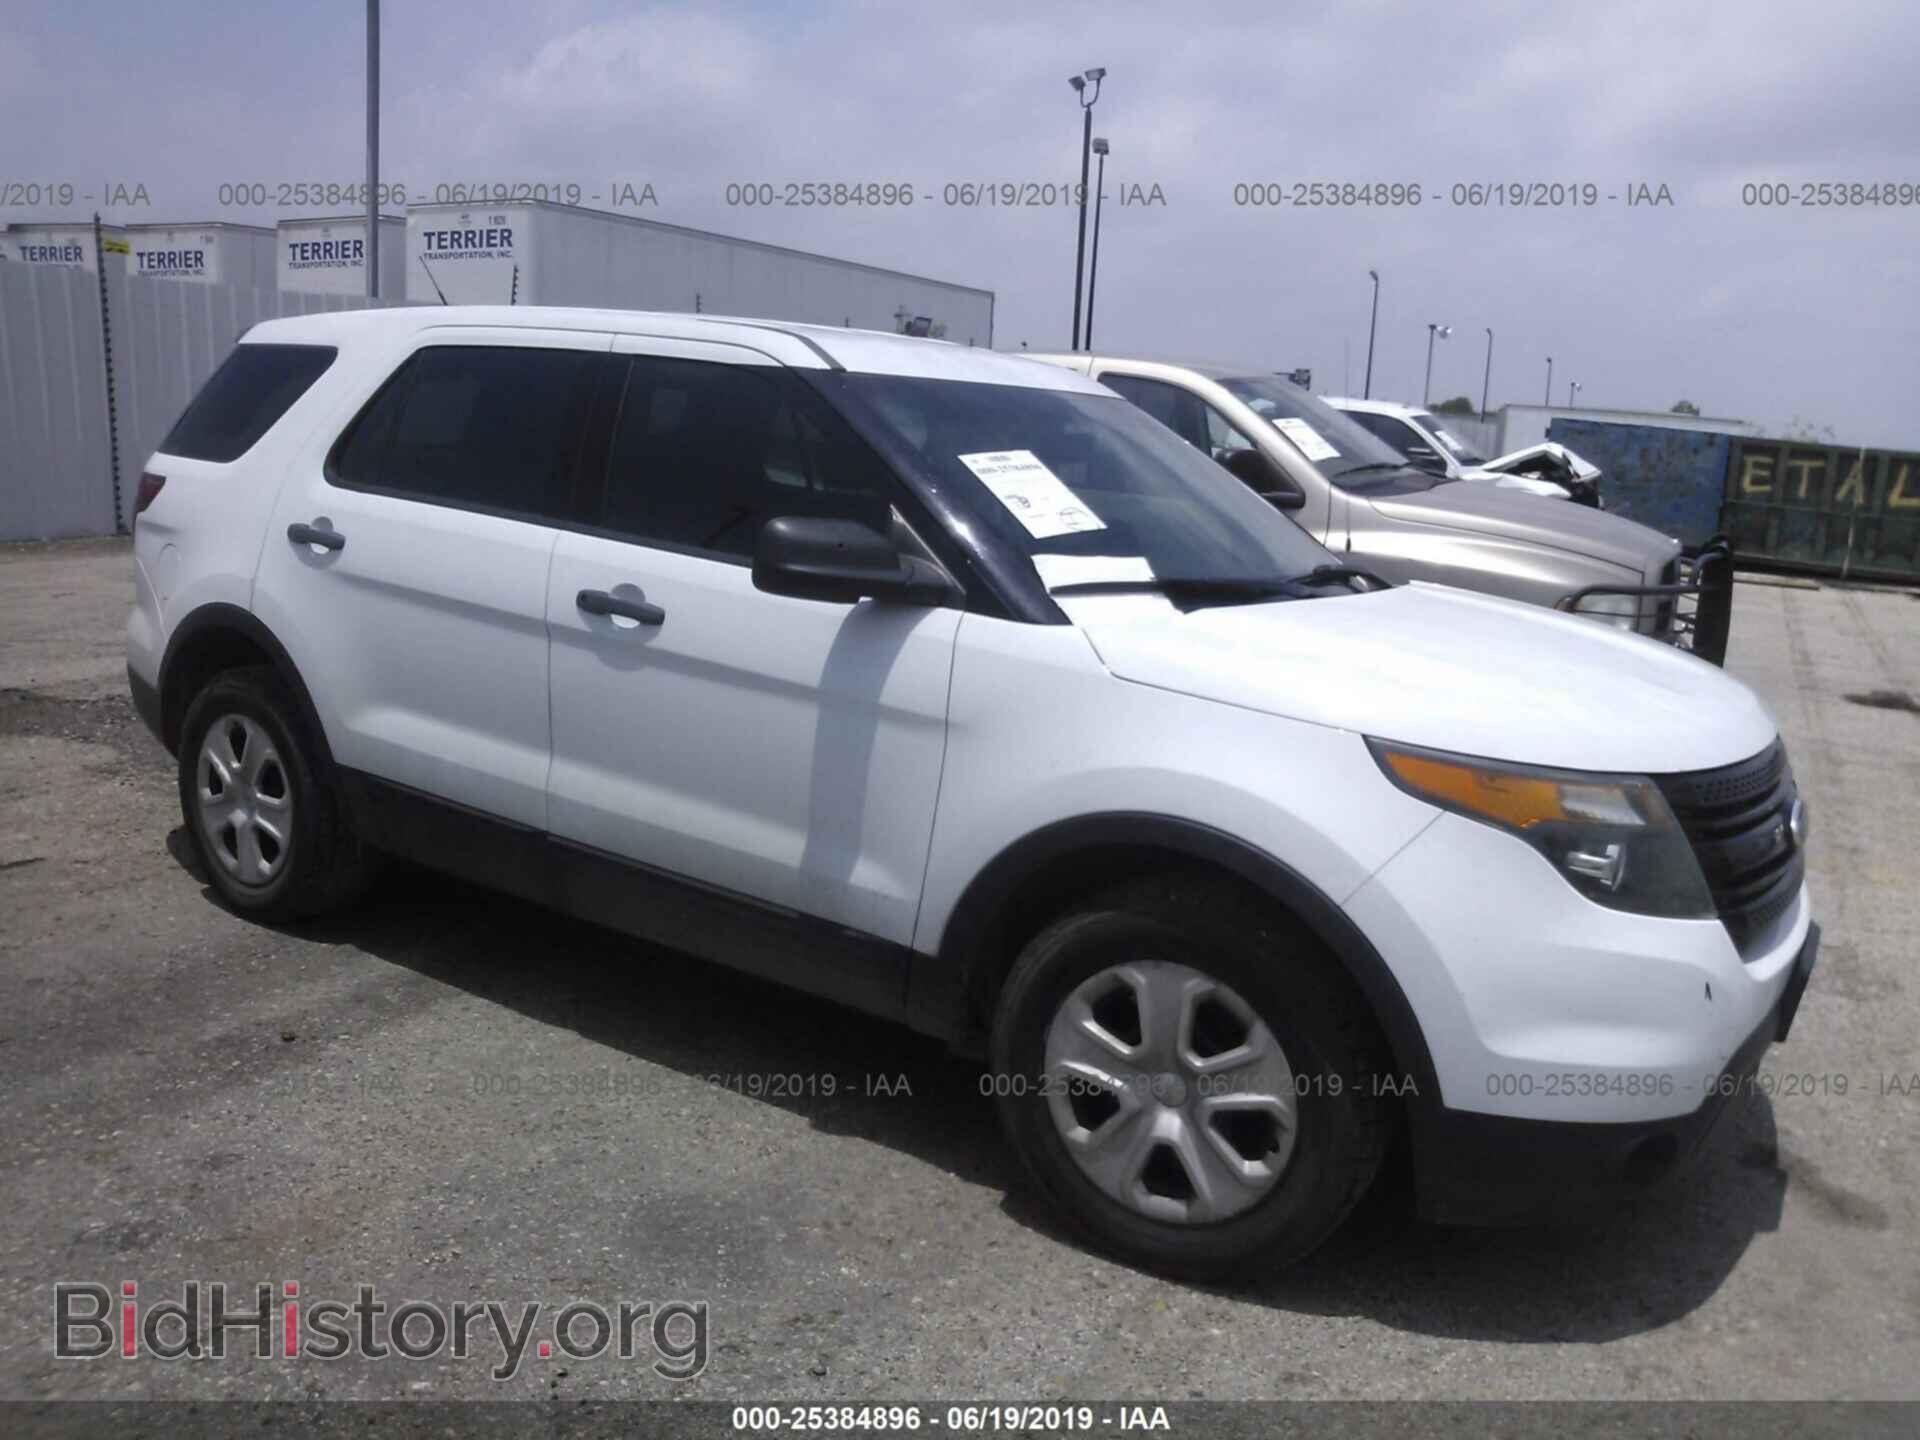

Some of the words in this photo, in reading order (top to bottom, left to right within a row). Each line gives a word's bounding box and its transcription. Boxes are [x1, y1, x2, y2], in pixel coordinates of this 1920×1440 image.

[423, 228, 513, 250] TERRIER
[19, 245, 84, 262] TERRIER
[135, 250, 204, 269] TERRIER
[288, 239, 364, 261] TERRIER
